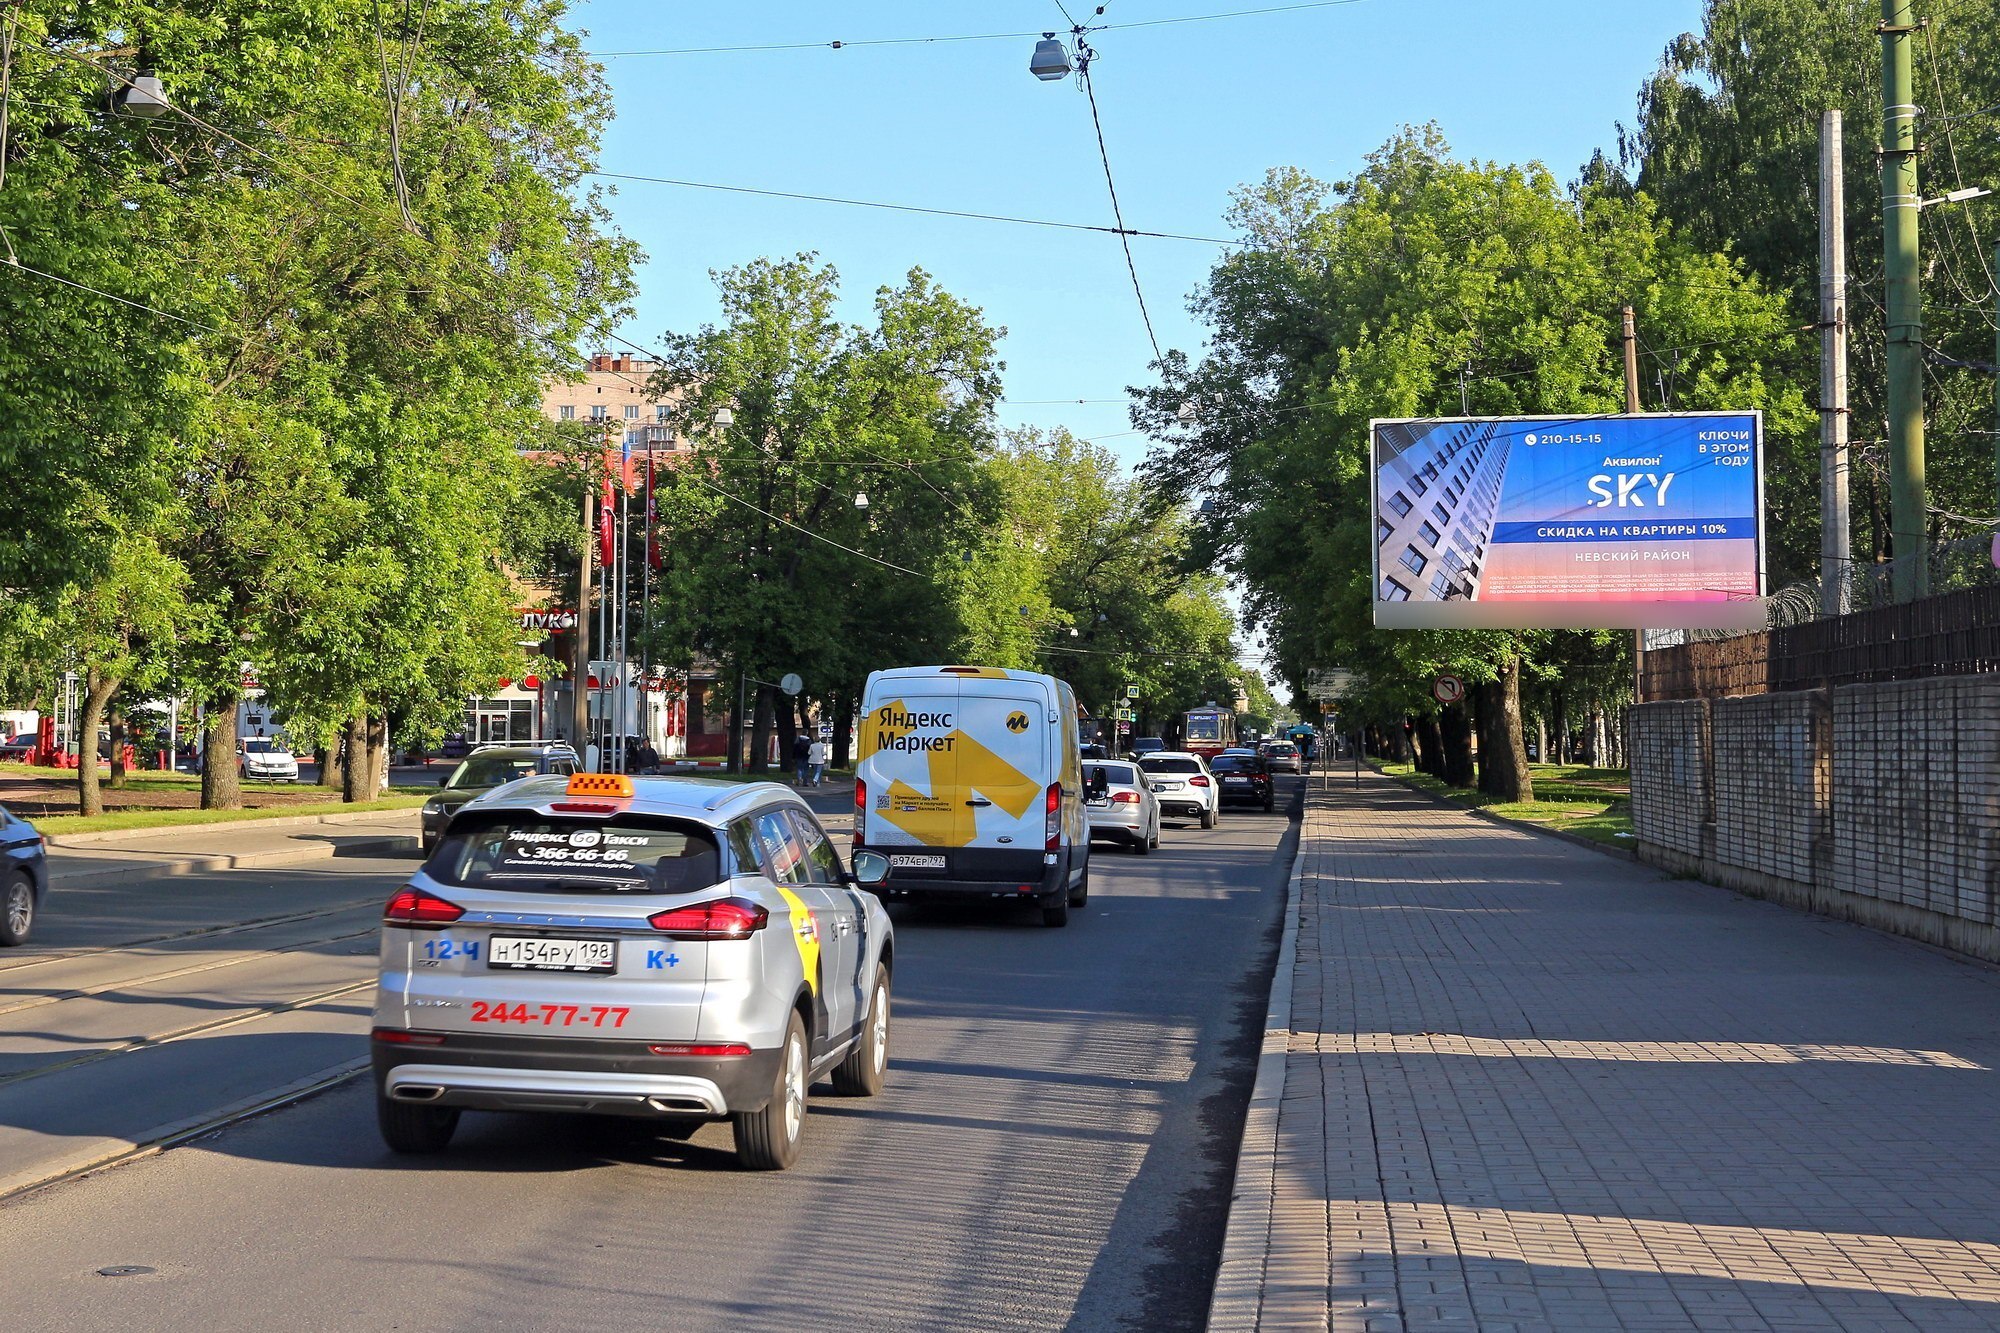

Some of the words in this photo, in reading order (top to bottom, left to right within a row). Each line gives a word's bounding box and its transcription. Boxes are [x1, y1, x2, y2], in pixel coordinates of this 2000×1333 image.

[1541, 434, 1602, 444] 210-15-15
[1699, 431, 1750, 441] КЛЮЧИ
[1699, 444, 1707, 453] В
[1711, 443, 1749, 453] ЭТОМ
[1715, 456, 1750, 467] ГОДУ
[1587, 473, 1675, 508] SKY
[1537, 527, 1595, 538] СКИДКА
[1600, 526, 1618, 537] НА
[1623, 525, 1697, 536] КВАРТИРЫ
[1701, 524, 1727, 535] 10%
[1575, 550, 1639, 562] НЕВСКИЙ
[1643, 549, 1691, 561] РАЙОН
[879, 707, 952, 730] Яндекс
[877, 731, 955, 754] Маркет
[507, 831, 569, 843] Яндекс
[602, 833, 650, 846] Такси
[533, 847, 629, 861] 366-66-66
[549, 860, 563, 868] App
[595, 862, 619, 870] Google
[471, 1001, 630, 1028] 244-77-77
